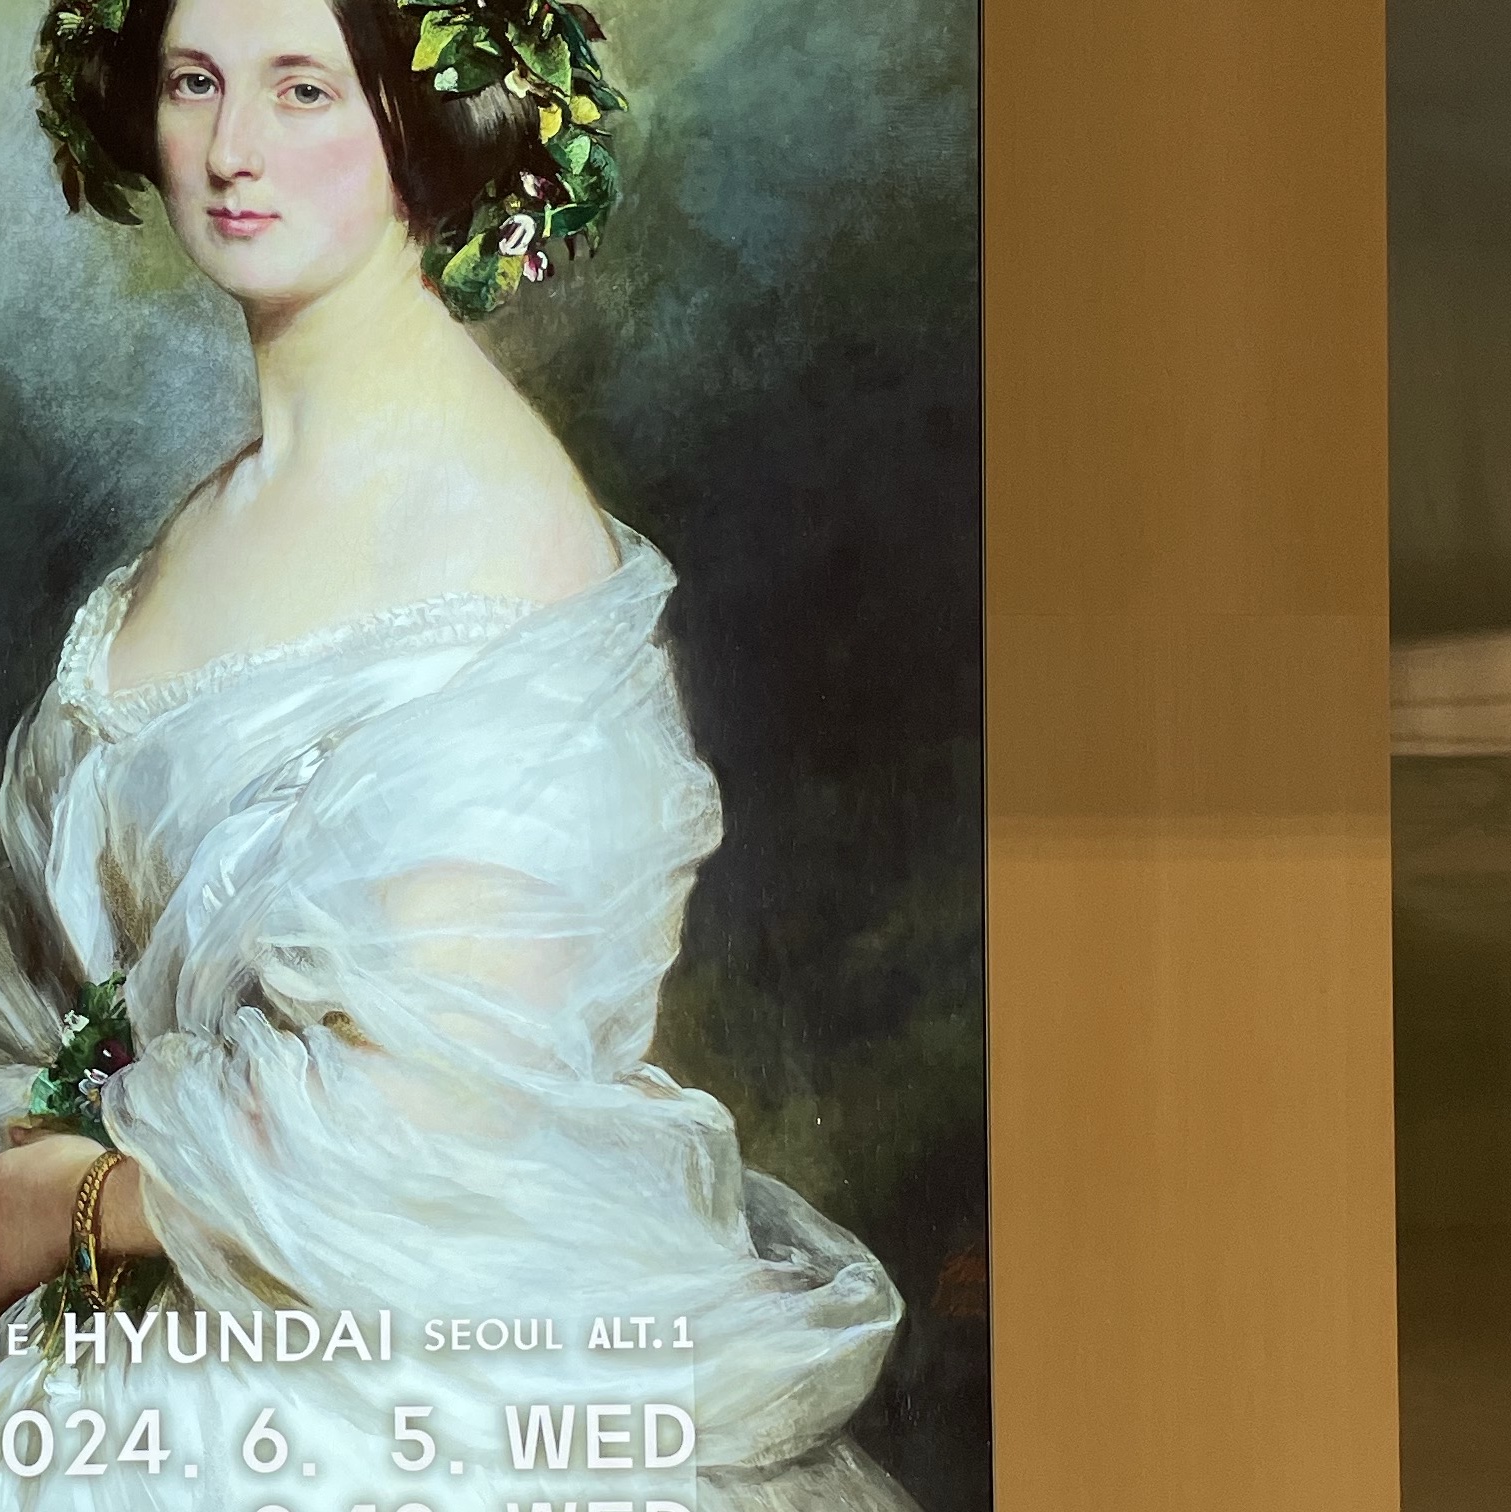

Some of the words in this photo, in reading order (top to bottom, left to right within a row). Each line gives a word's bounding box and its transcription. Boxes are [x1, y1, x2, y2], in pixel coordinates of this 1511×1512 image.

[65, 1309, 392, 1365] HYUNDAI
[423, 1316, 564, 1351] SEOUL
[241, 1406, 317, 1477] 6.
[390, 1404, 465, 1475] 5.
[505, 1402, 697, 1471] WED
